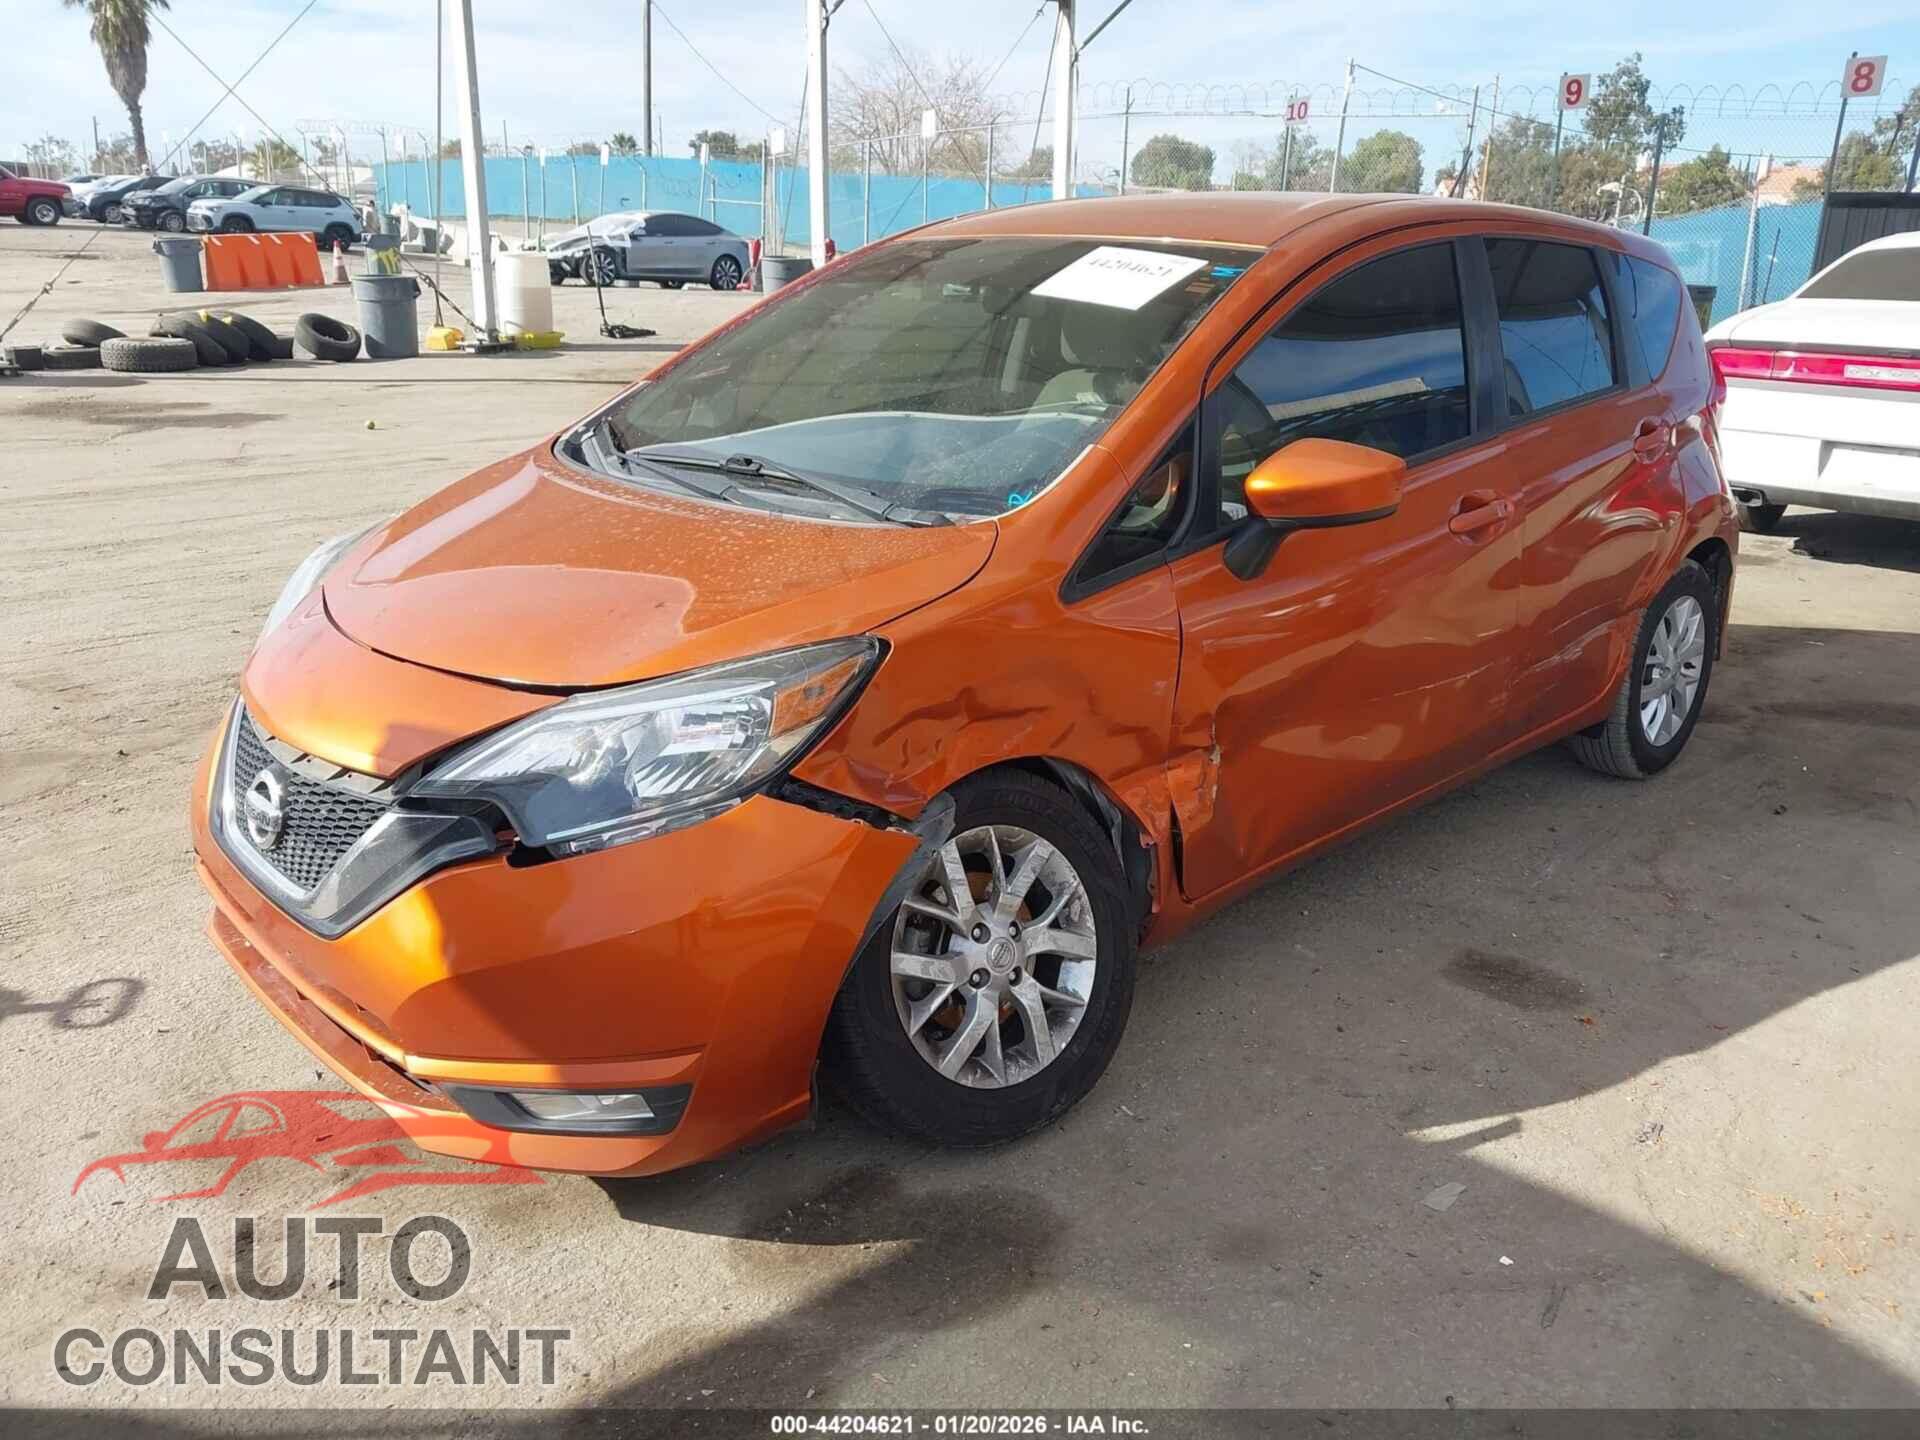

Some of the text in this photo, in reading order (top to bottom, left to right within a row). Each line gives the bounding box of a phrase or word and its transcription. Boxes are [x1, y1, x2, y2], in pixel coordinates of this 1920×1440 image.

[1850, 61, 1876, 93] 8
[1565, 78, 1583, 106] 9
[1286, 101, 1308, 121] 10
